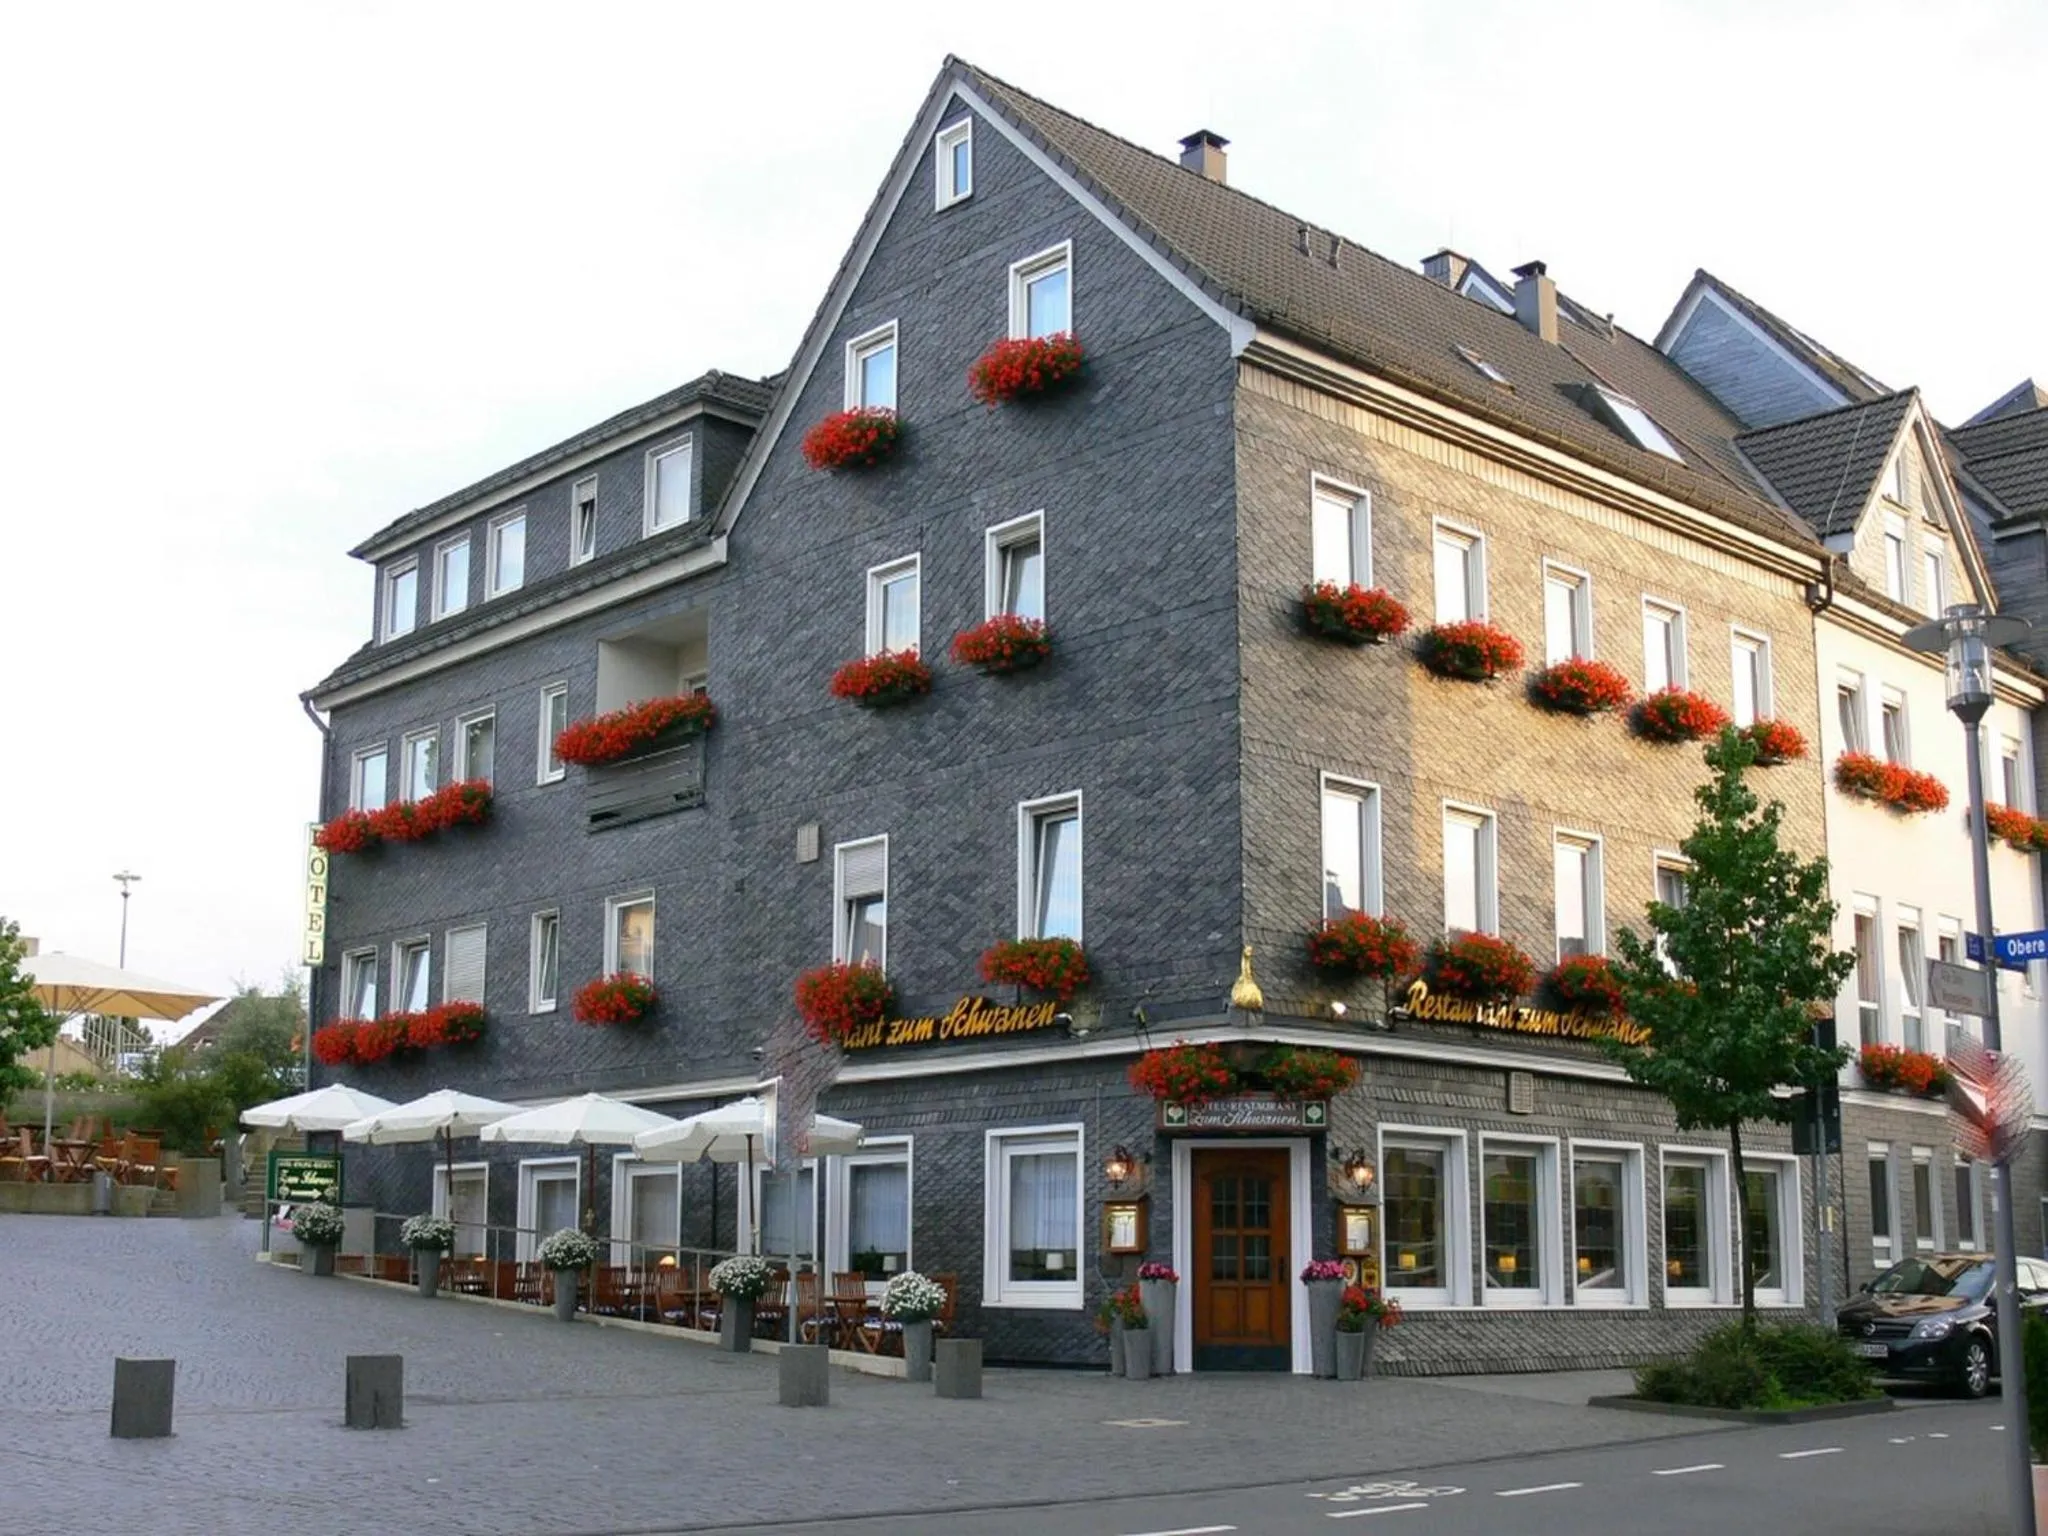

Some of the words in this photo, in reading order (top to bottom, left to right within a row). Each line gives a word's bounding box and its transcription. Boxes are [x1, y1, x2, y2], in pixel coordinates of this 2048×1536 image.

[2007, 939, 2046, 956] Obere
[886, 1016, 934, 1046] zum
[939, 994, 1056, 1040] Schwanen
[1403, 978, 1515, 1029] Restaurant
[1516, 1007, 1559, 1034] zum
